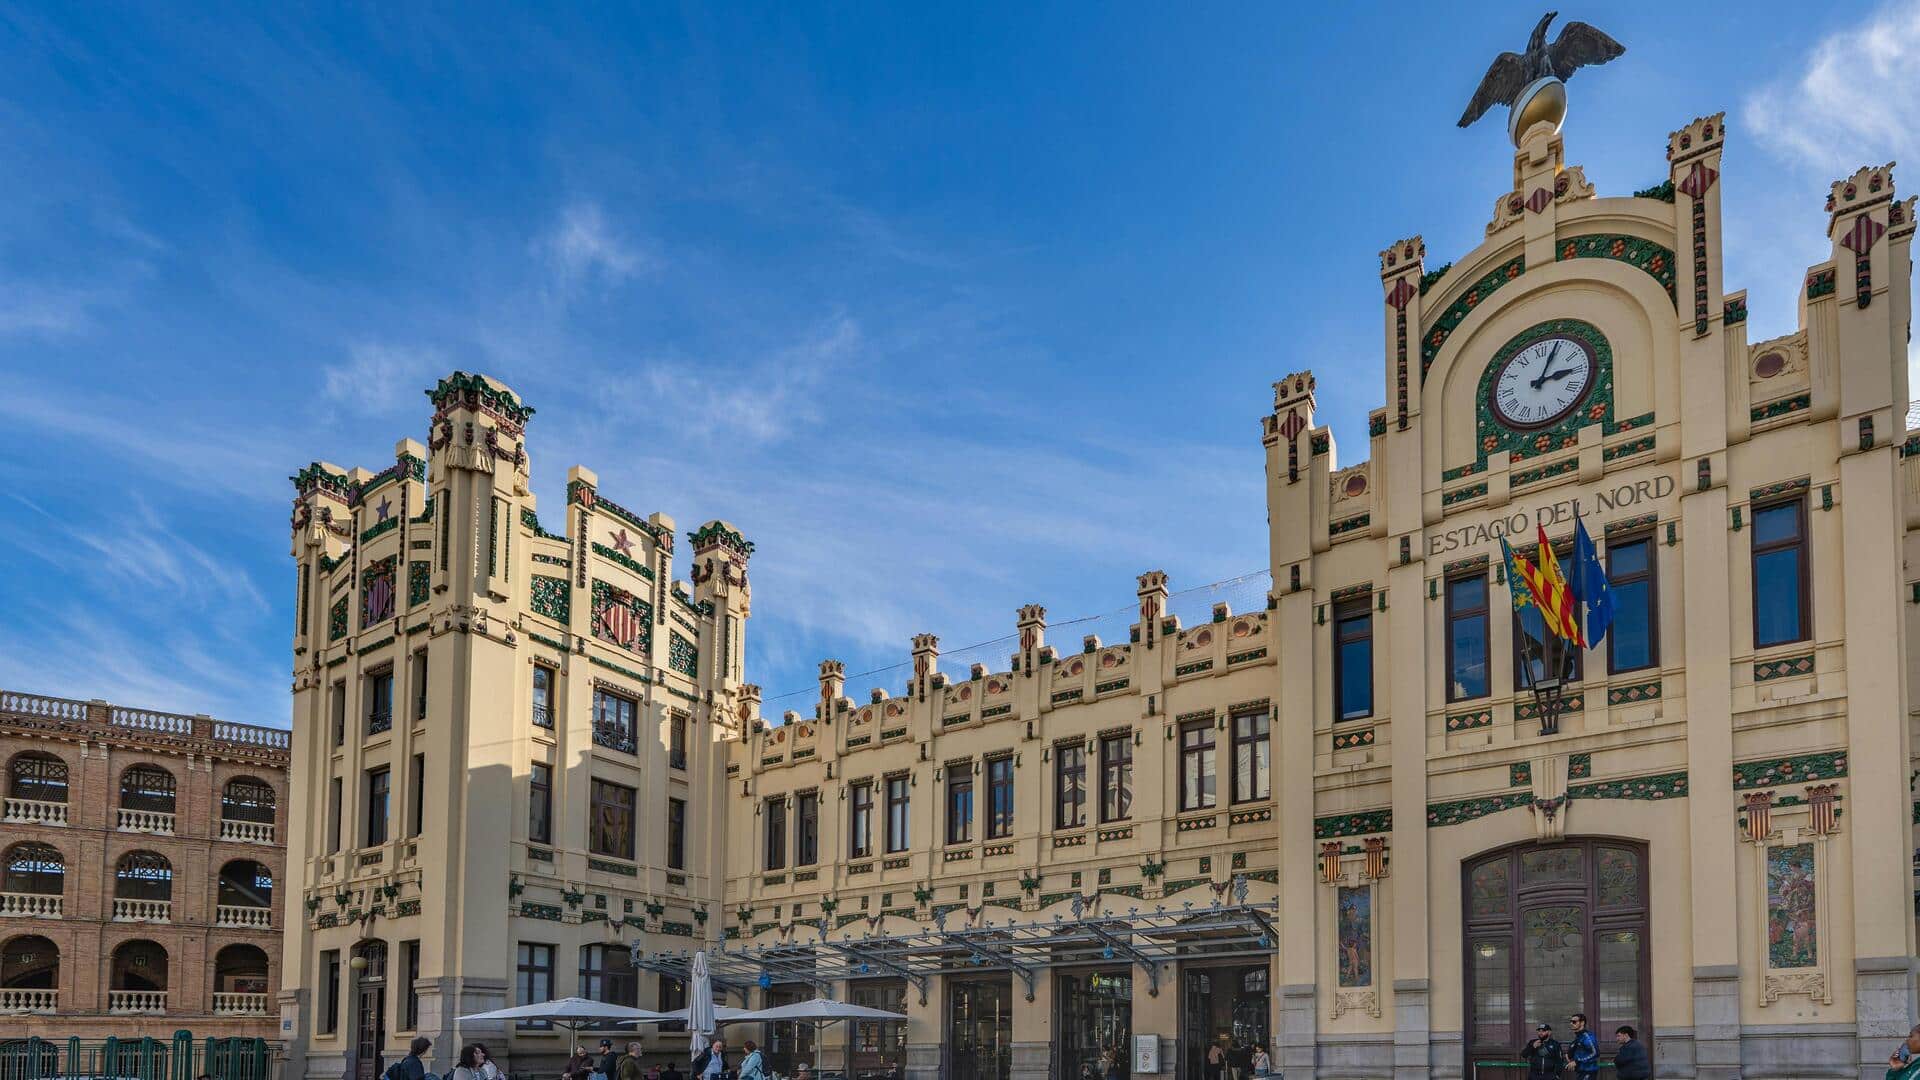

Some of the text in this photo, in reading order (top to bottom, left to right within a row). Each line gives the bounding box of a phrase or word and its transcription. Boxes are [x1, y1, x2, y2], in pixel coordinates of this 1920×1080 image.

[1428, 475, 1675, 556] ESTACIÓ DEL NORD
